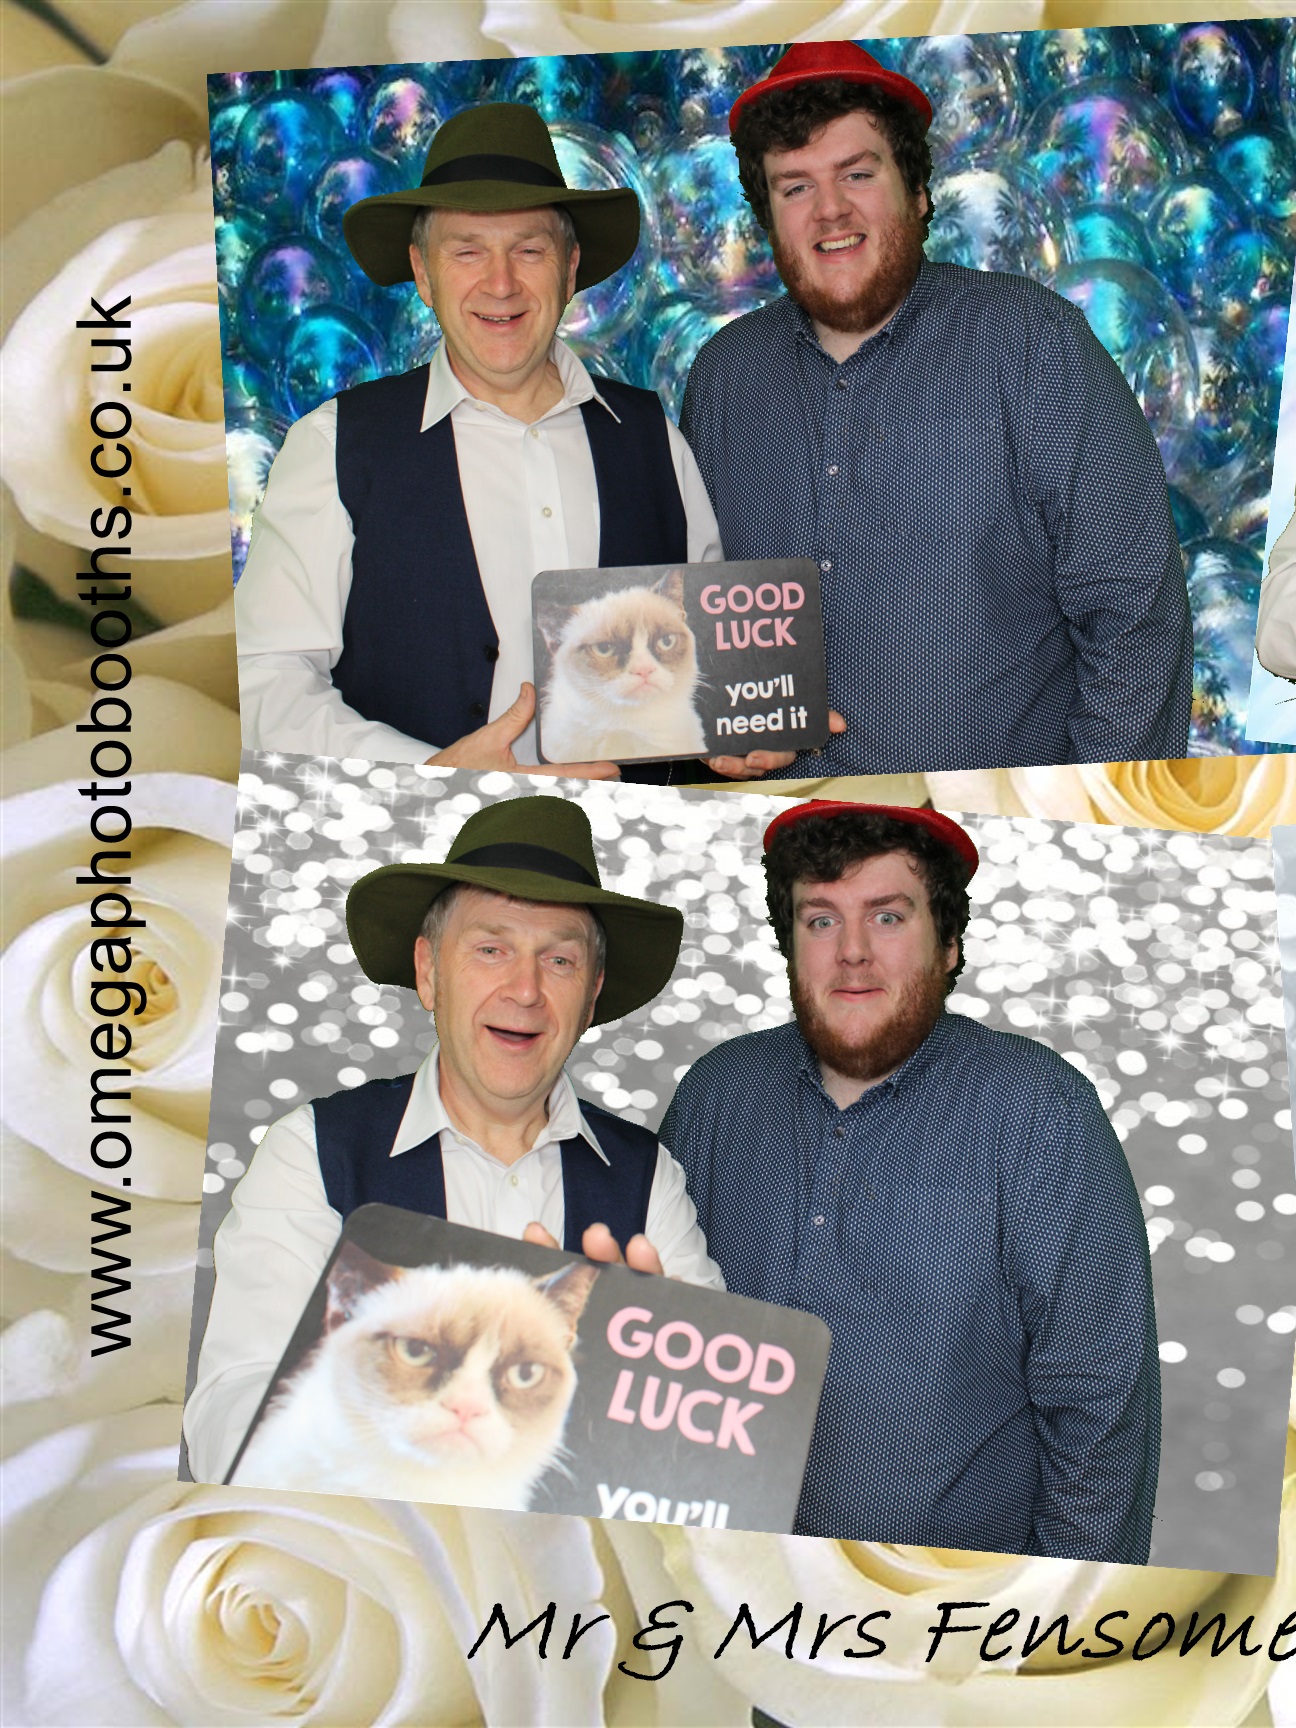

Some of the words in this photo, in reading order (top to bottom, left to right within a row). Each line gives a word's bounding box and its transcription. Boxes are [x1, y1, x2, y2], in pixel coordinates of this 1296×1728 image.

[700, 582, 805, 615] GOOD
[715, 617, 797, 651] LUCK
[716, 709, 784, 736] need
[789, 706, 808, 729] it
[606, 1306, 796, 1396] GOOD
[606, 1369, 765, 1456] LUCK
